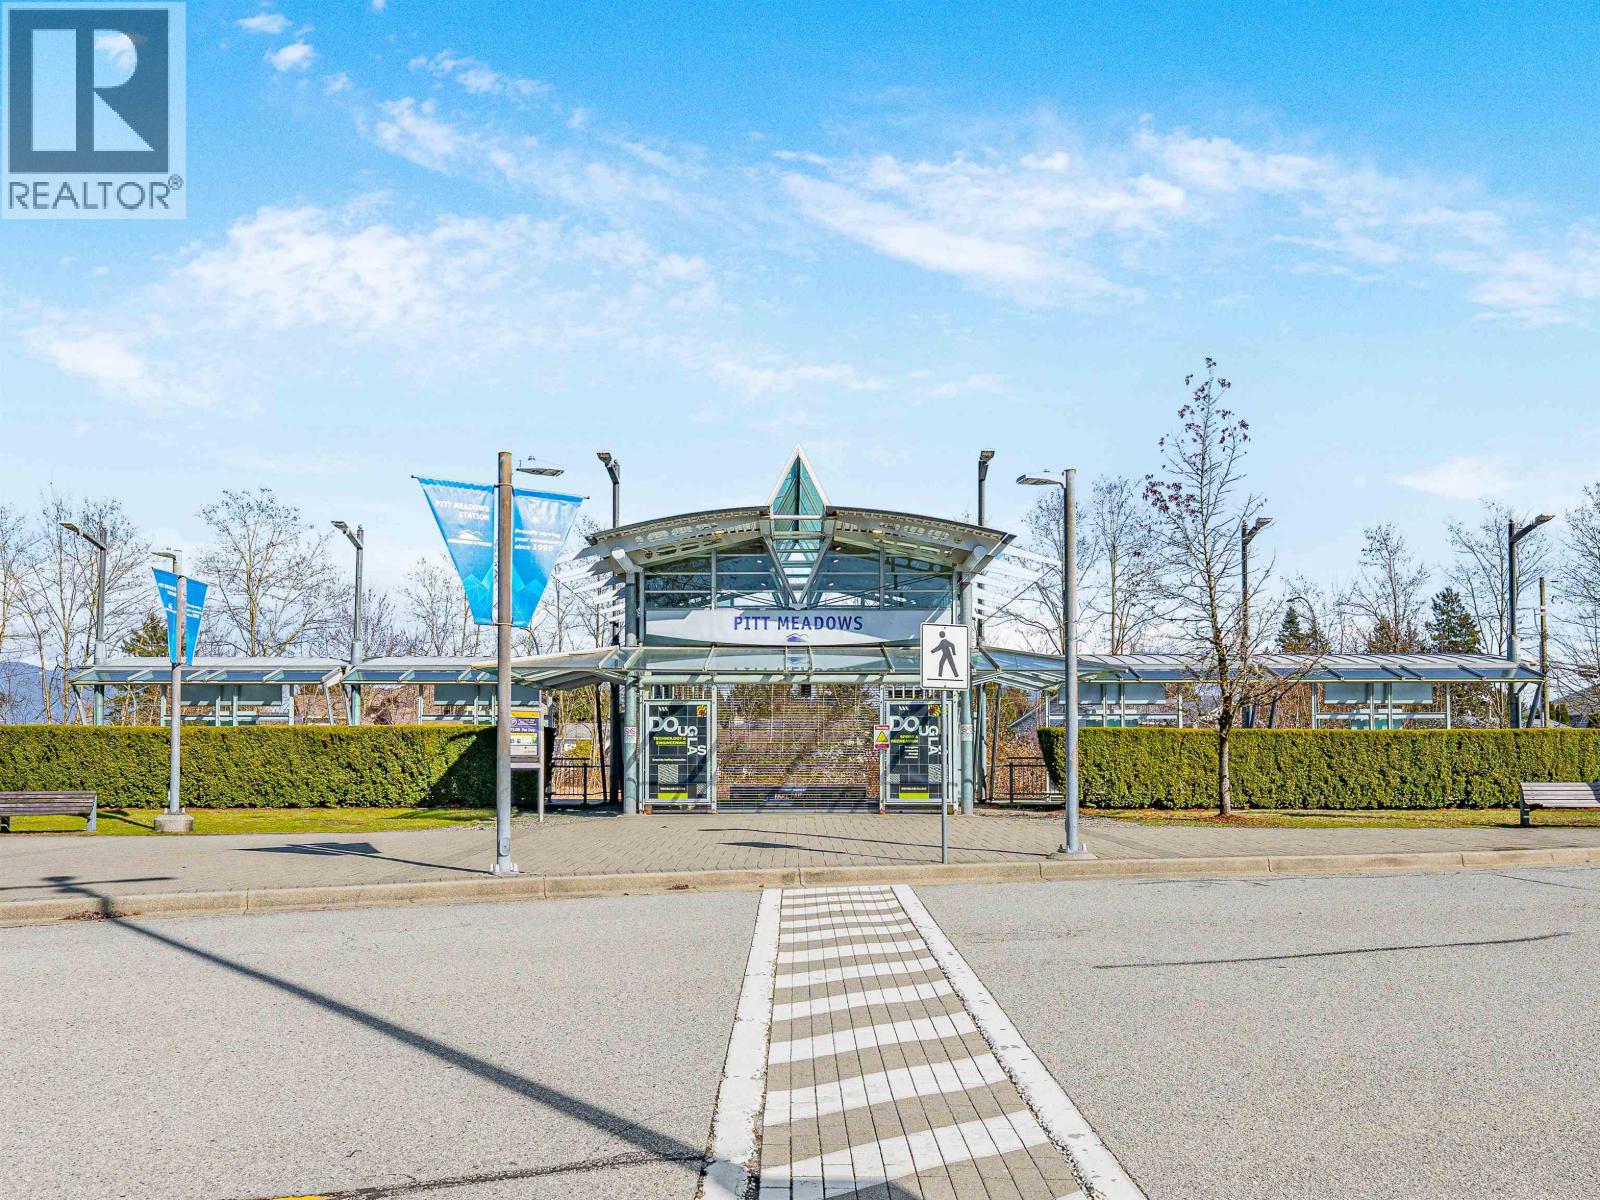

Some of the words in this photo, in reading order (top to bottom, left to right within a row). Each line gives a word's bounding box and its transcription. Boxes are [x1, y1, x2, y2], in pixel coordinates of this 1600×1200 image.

[435, 500, 451, 509] PITT
[452, 502, 490, 512] MEADOWS
[460, 512, 490, 521] STATION
[733, 615, 771, 631] PITT
[777, 615, 863, 631] MEADOWS
